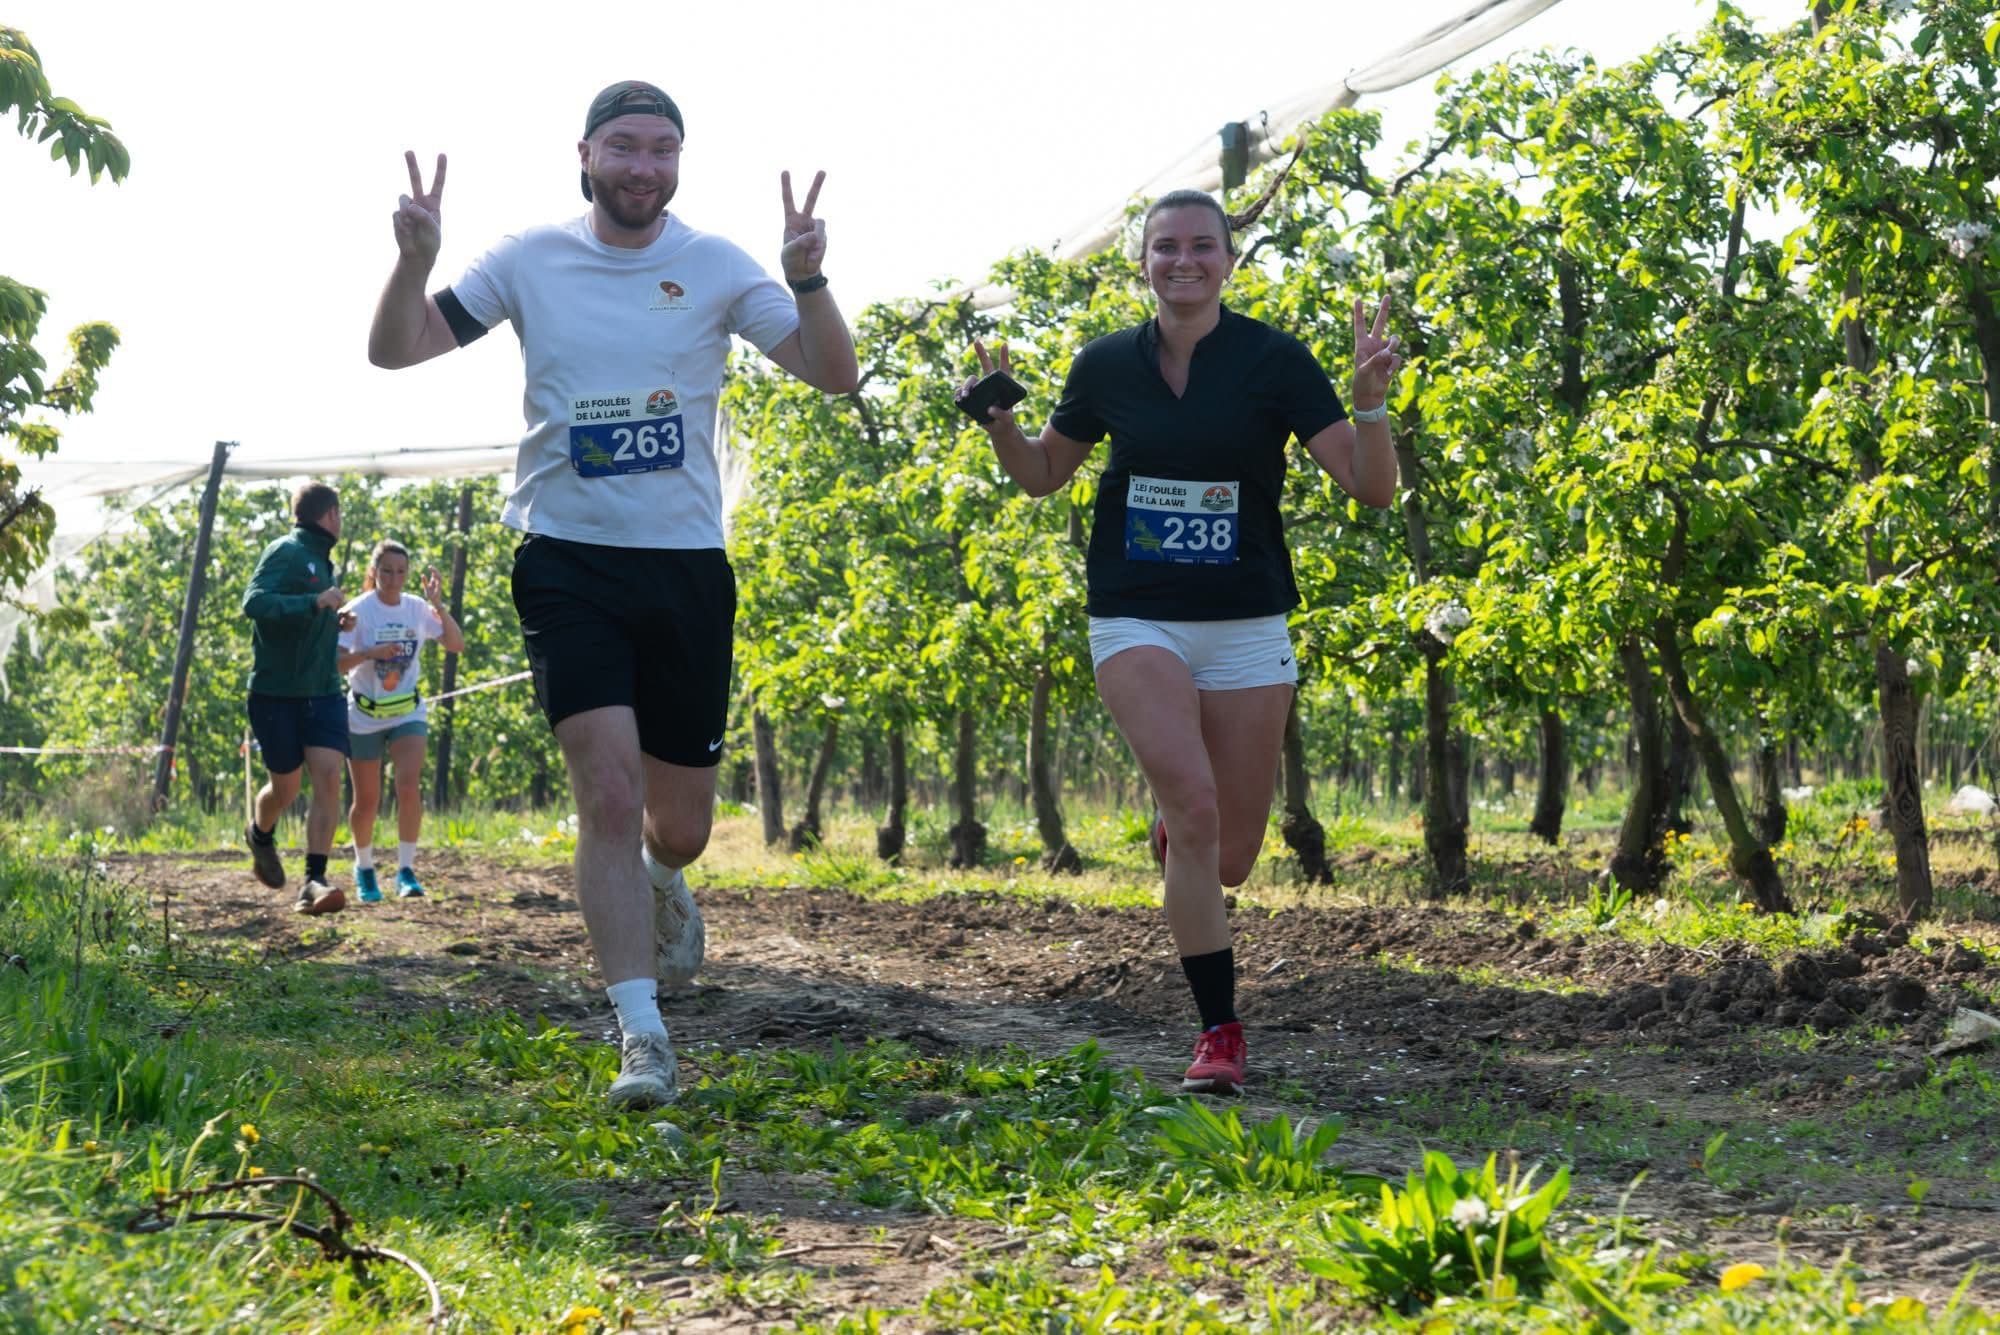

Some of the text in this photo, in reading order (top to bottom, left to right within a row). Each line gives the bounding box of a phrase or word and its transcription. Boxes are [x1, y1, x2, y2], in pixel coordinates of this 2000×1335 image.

[575, 396, 631, 409] LES FOULÉES
[576, 409, 631, 421] DE LA LAWE
[611, 422, 681, 461] 263
[1135, 483, 1187, 496] LES FOULÉES
[1133, 495, 1186, 507] DE LA LAWE
[1161, 516, 1232, 551] 238
